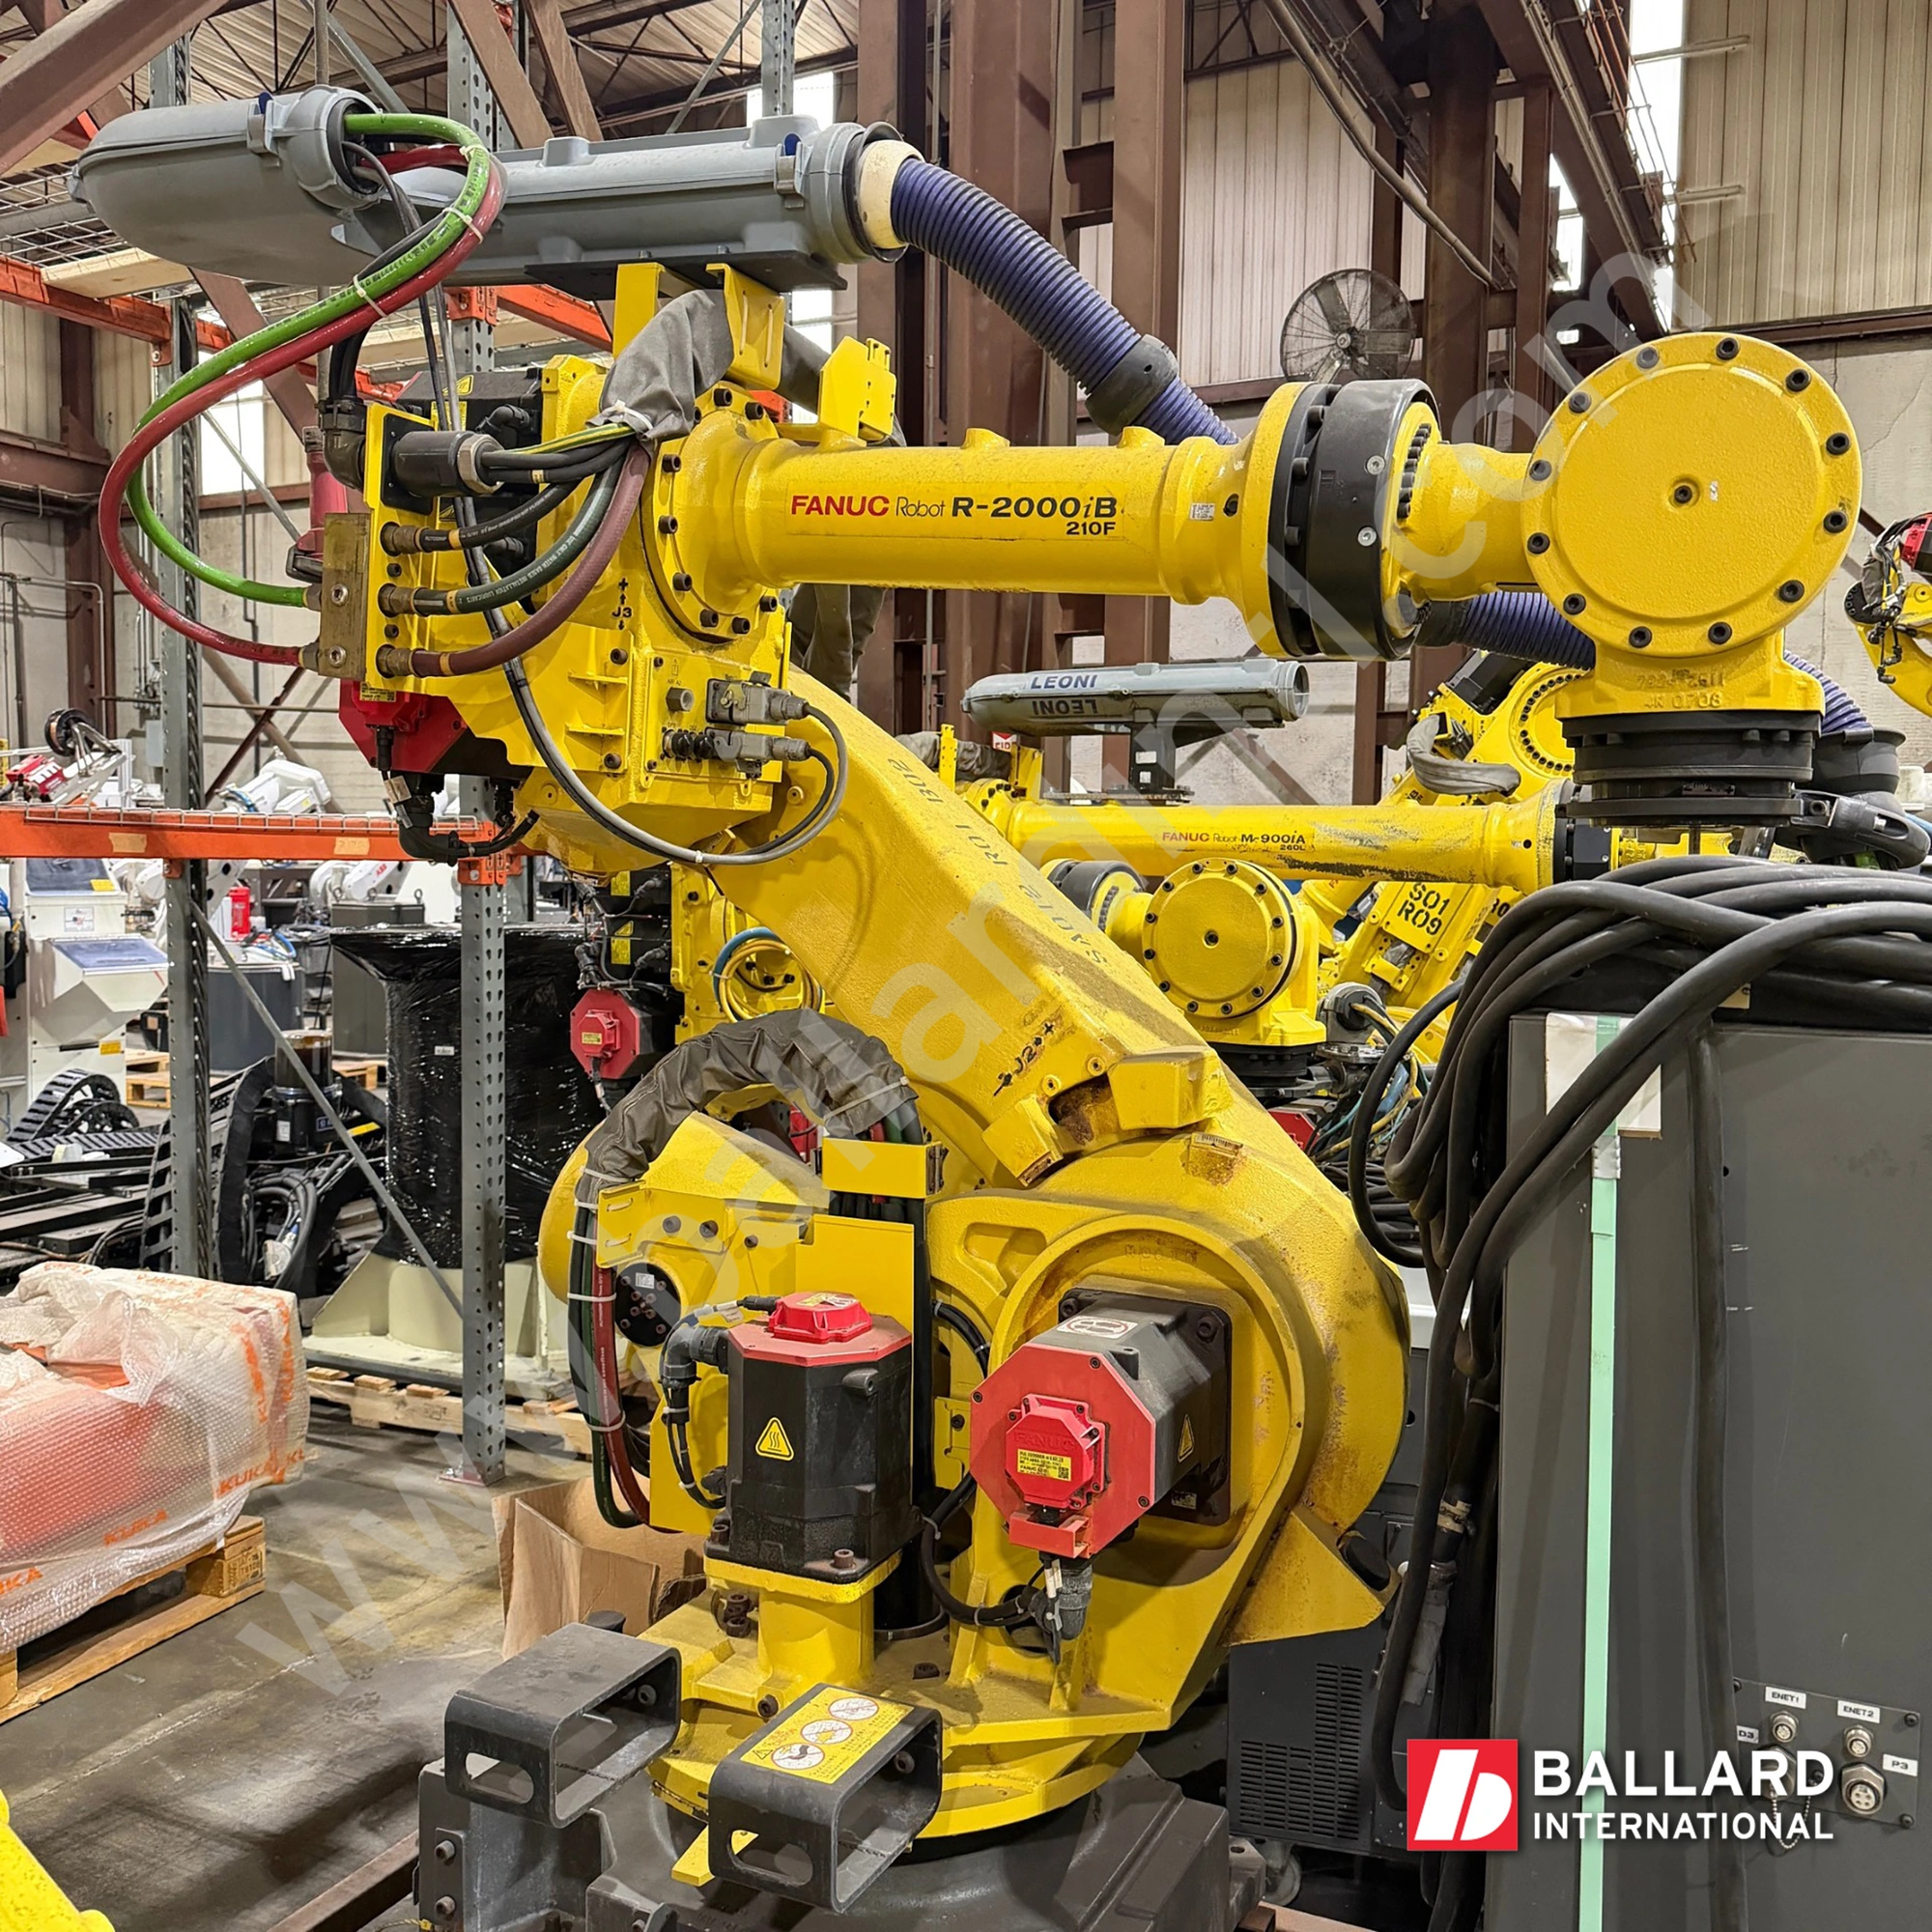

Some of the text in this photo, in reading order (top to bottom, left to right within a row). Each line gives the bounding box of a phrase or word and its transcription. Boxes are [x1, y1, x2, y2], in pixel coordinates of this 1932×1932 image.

[791, 495, 1118, 519] FANUC Robot R-2000iB
[1065, 522, 1117, 536] 210F
[611, 607, 633, 618] J3
[1030, 674, 1098, 690] LEONI
[1032, 698, 1097, 715] LEONI
[1162, 832, 1209, 842] FANUC
[1212, 833, 1236, 842] Robot
[1397, 899, 1443, 936] R09
[1013, 1045, 1037, 1074] J2
[1015, 1433, 1075, 1452] FANUC
[1771, 1691, 1801, 1703] ENET1
[1842, 1705, 1875, 1718] ENET2
[1890, 1760, 1910, 1771] P3
